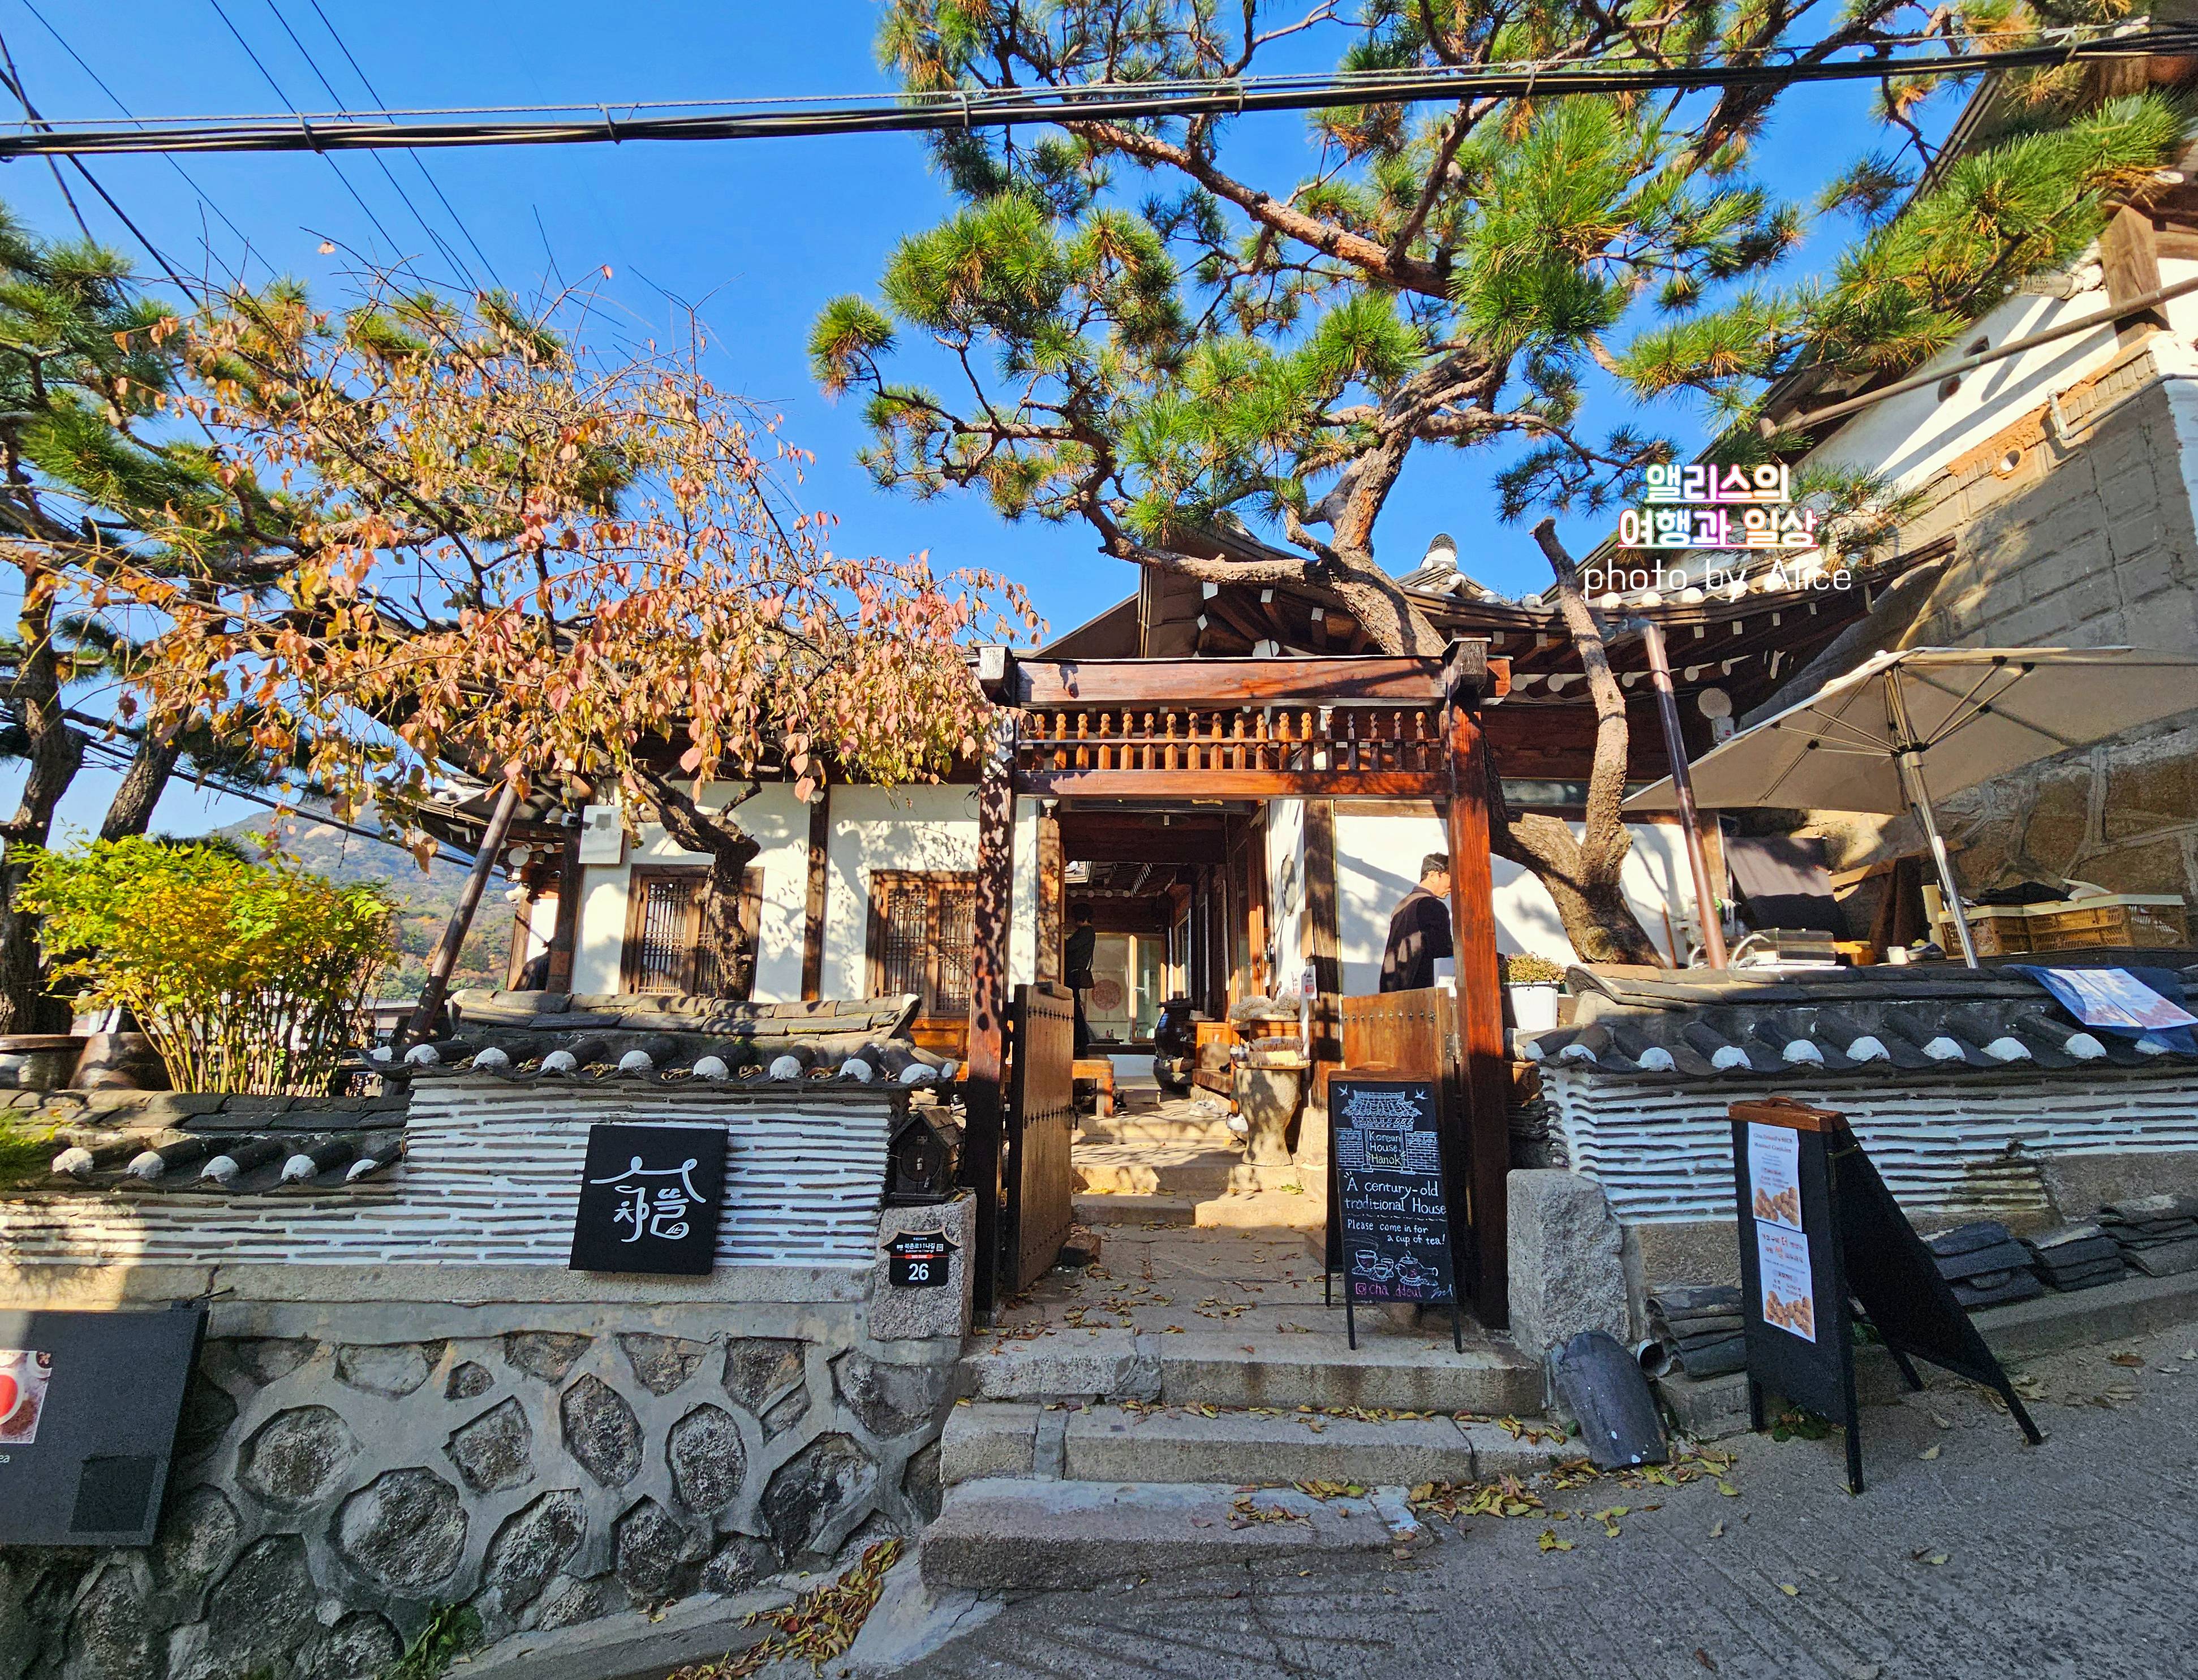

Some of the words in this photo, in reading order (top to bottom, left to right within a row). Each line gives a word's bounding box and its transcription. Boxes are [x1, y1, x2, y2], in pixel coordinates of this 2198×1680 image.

[1369, 1131, 1401, 1142] Korean
[1371, 1154, 1402, 1166] Hanok
[1365, 1181, 1439, 1200] century-old
[1344, 1194, 1405, 1212] traditional
[1413, 1197, 1447, 1214] House
[1348, 1219, 1374, 1230] Please
[1380, 1224, 1401, 1232] come
[1396, 1235, 1410, 1247] cup
[1413, 1234, 1422, 1243] of
[1426, 1234, 1445, 1245] tea!
[908, 1263, 929, 1281] 26
